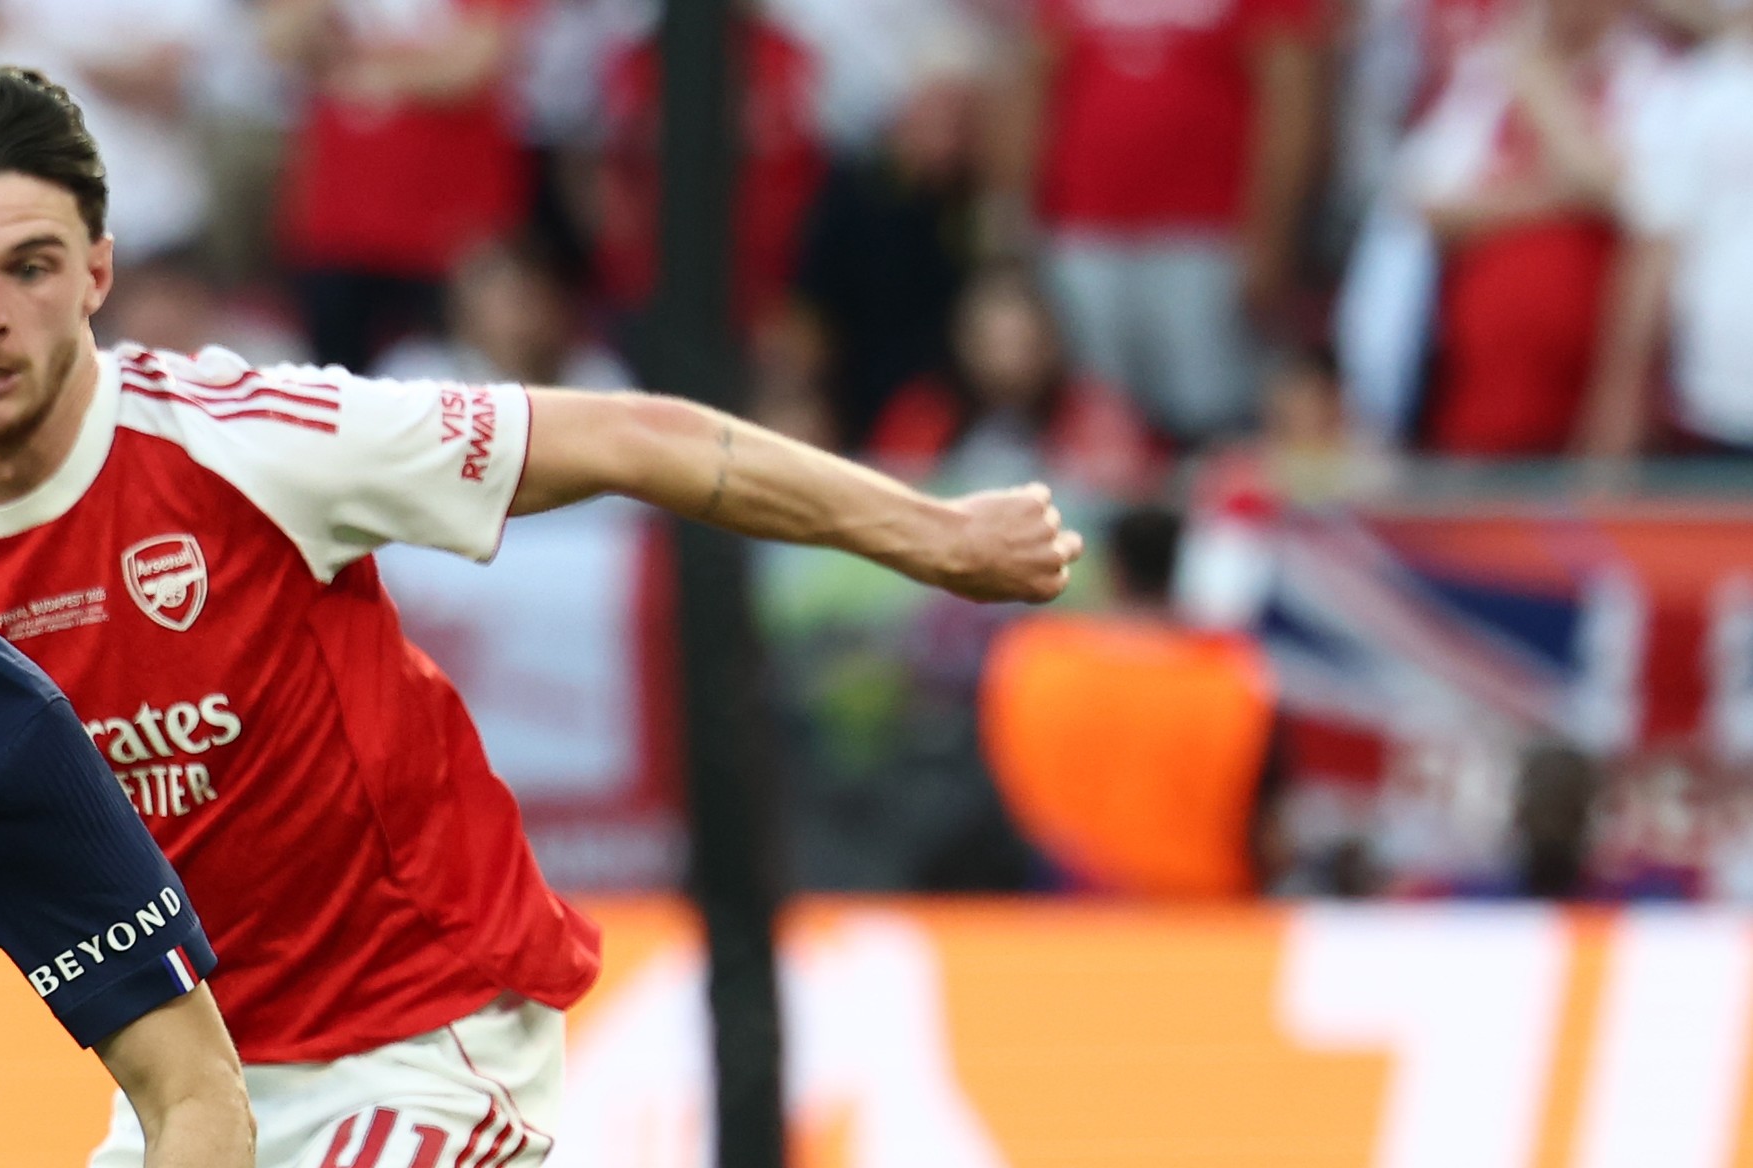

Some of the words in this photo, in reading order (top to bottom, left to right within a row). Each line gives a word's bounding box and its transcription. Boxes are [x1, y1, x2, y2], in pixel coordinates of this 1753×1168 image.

[136, 550, 192, 577] Arsenal
[82, 692, 242, 764] rates
[115, 762, 219, 818] ETTER
[28, 886, 181, 998] BEYOND
